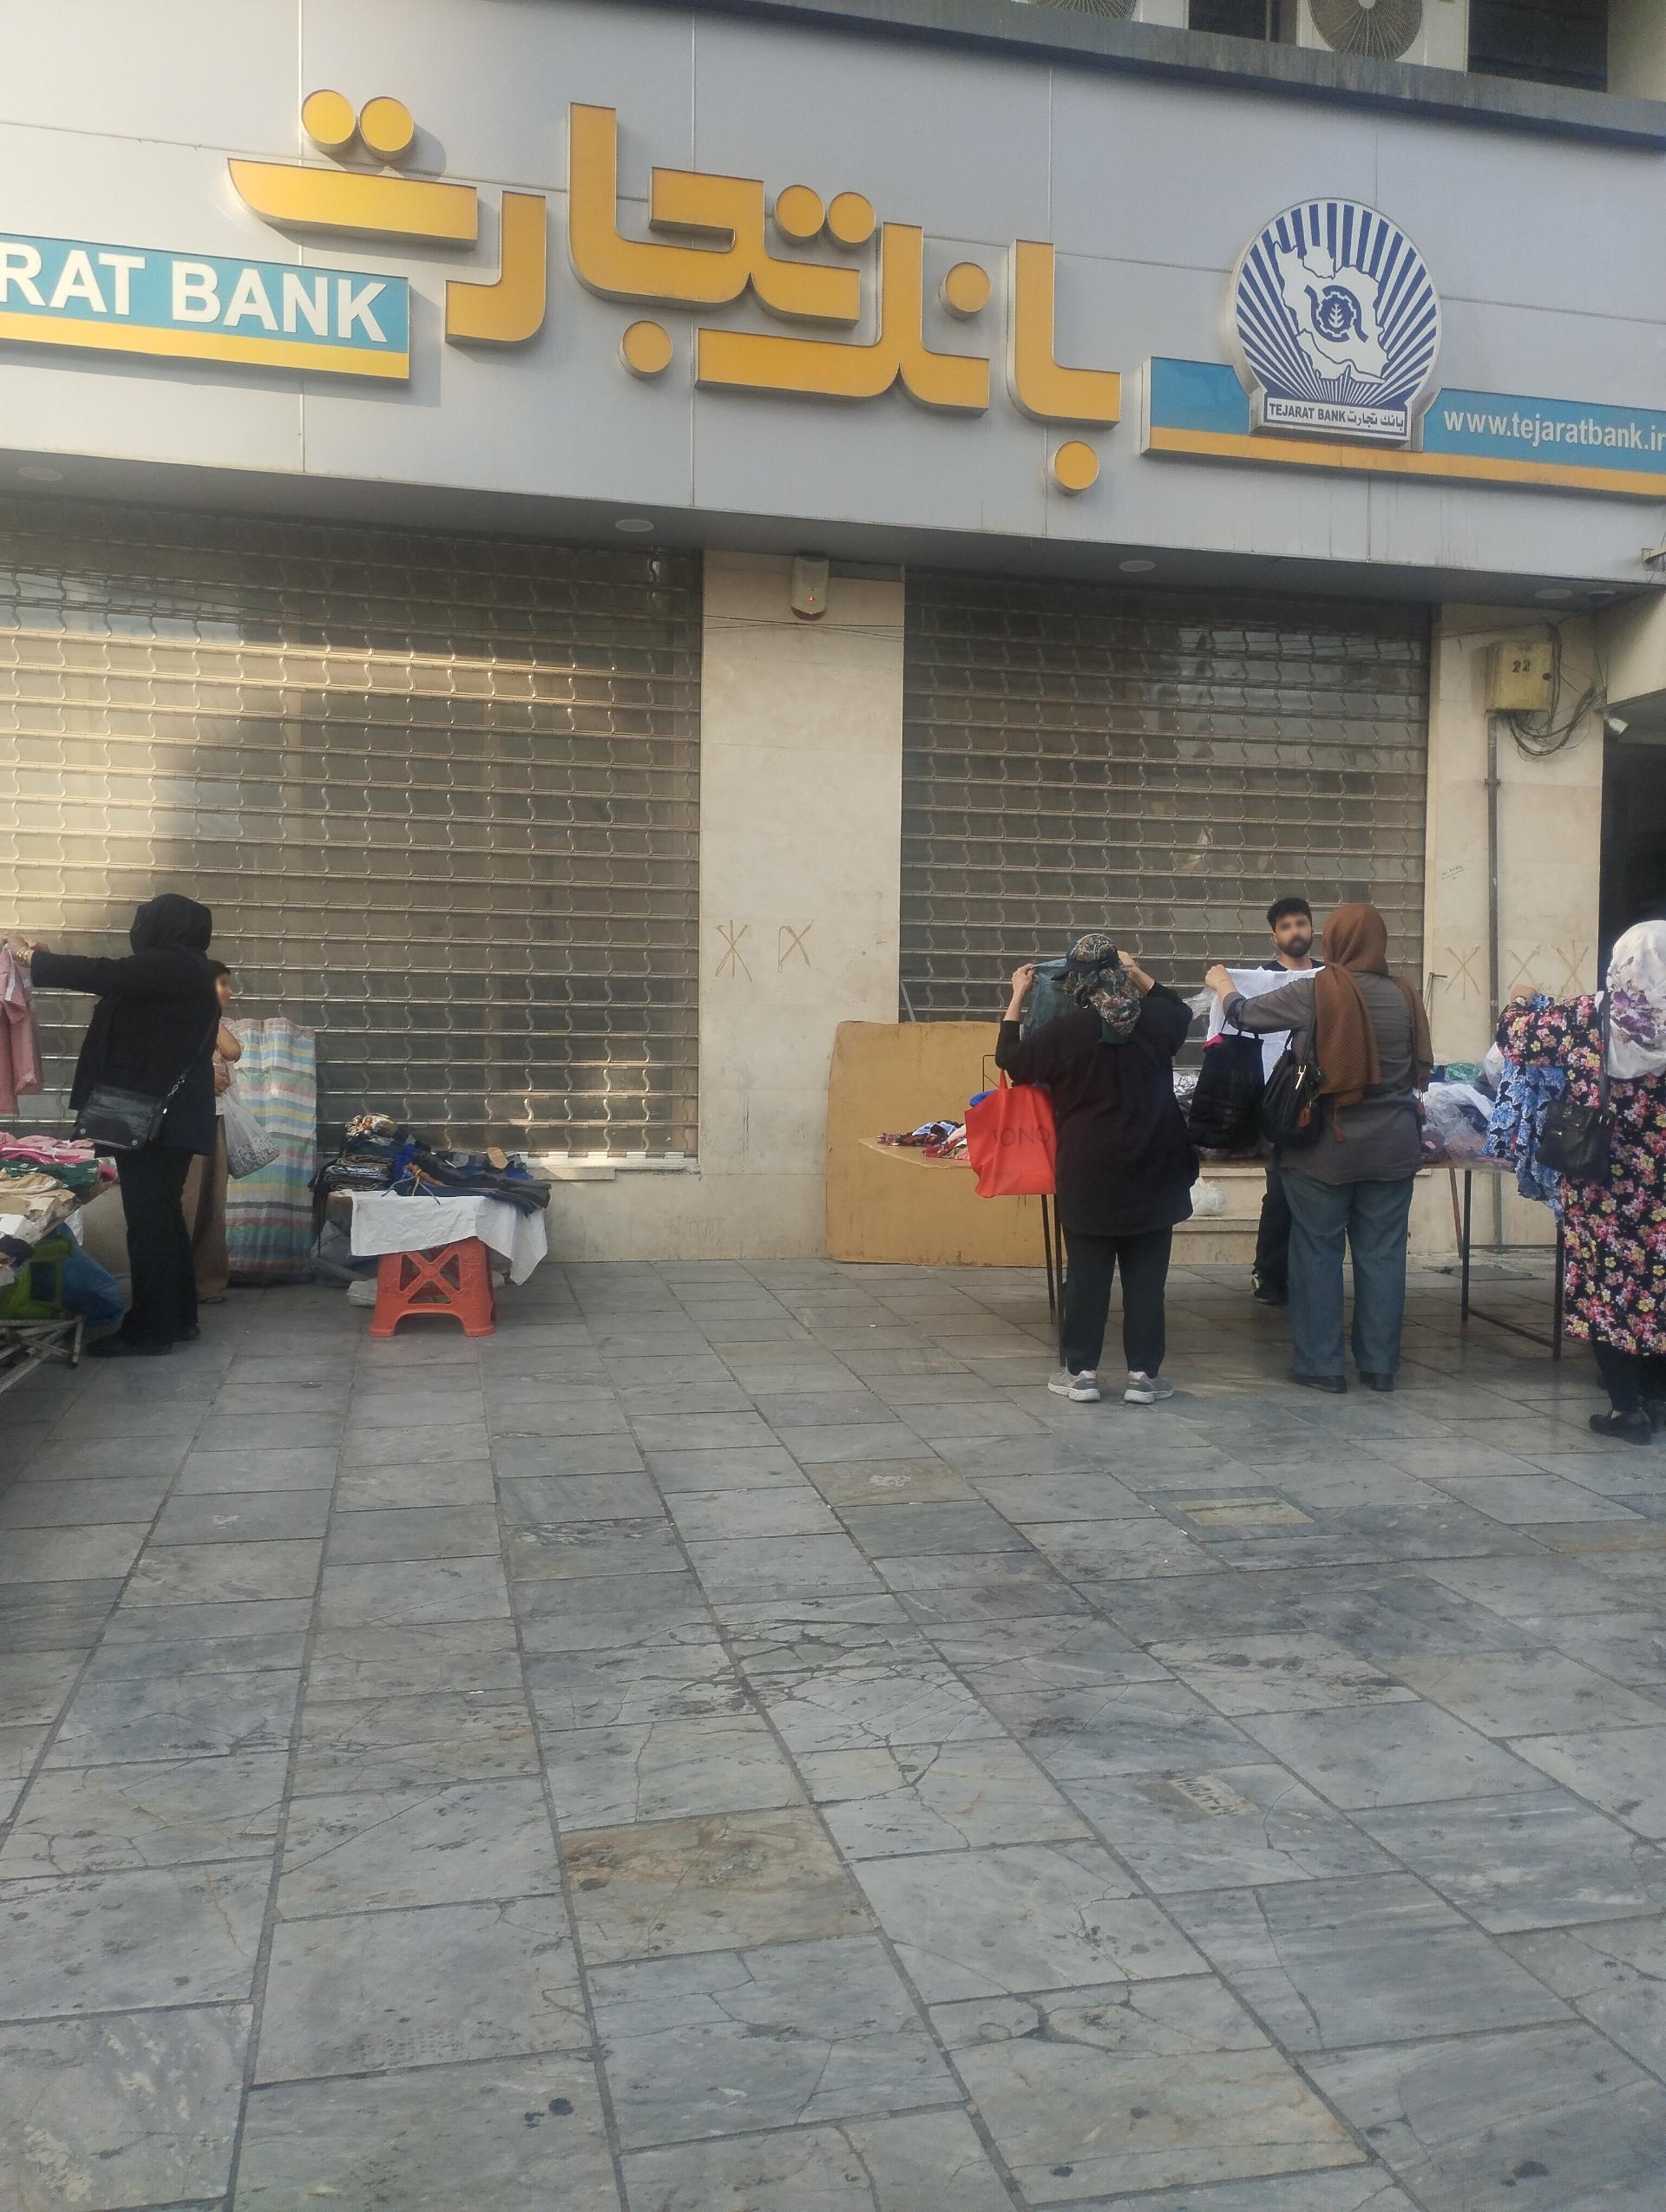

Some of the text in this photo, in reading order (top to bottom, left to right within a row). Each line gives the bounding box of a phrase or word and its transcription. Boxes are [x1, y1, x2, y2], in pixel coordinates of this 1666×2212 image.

[227, 88, 861, 379] تجارت
[172, 260, 388, 343] BANK
[1269, 402, 1346, 422] TEJARAT BANK
[1347, 411, 1378, 428] تجارت
[1444, 410, 1666, 451] www.tejaratbank.ir
[1512, 659, 1531, 673] 22
